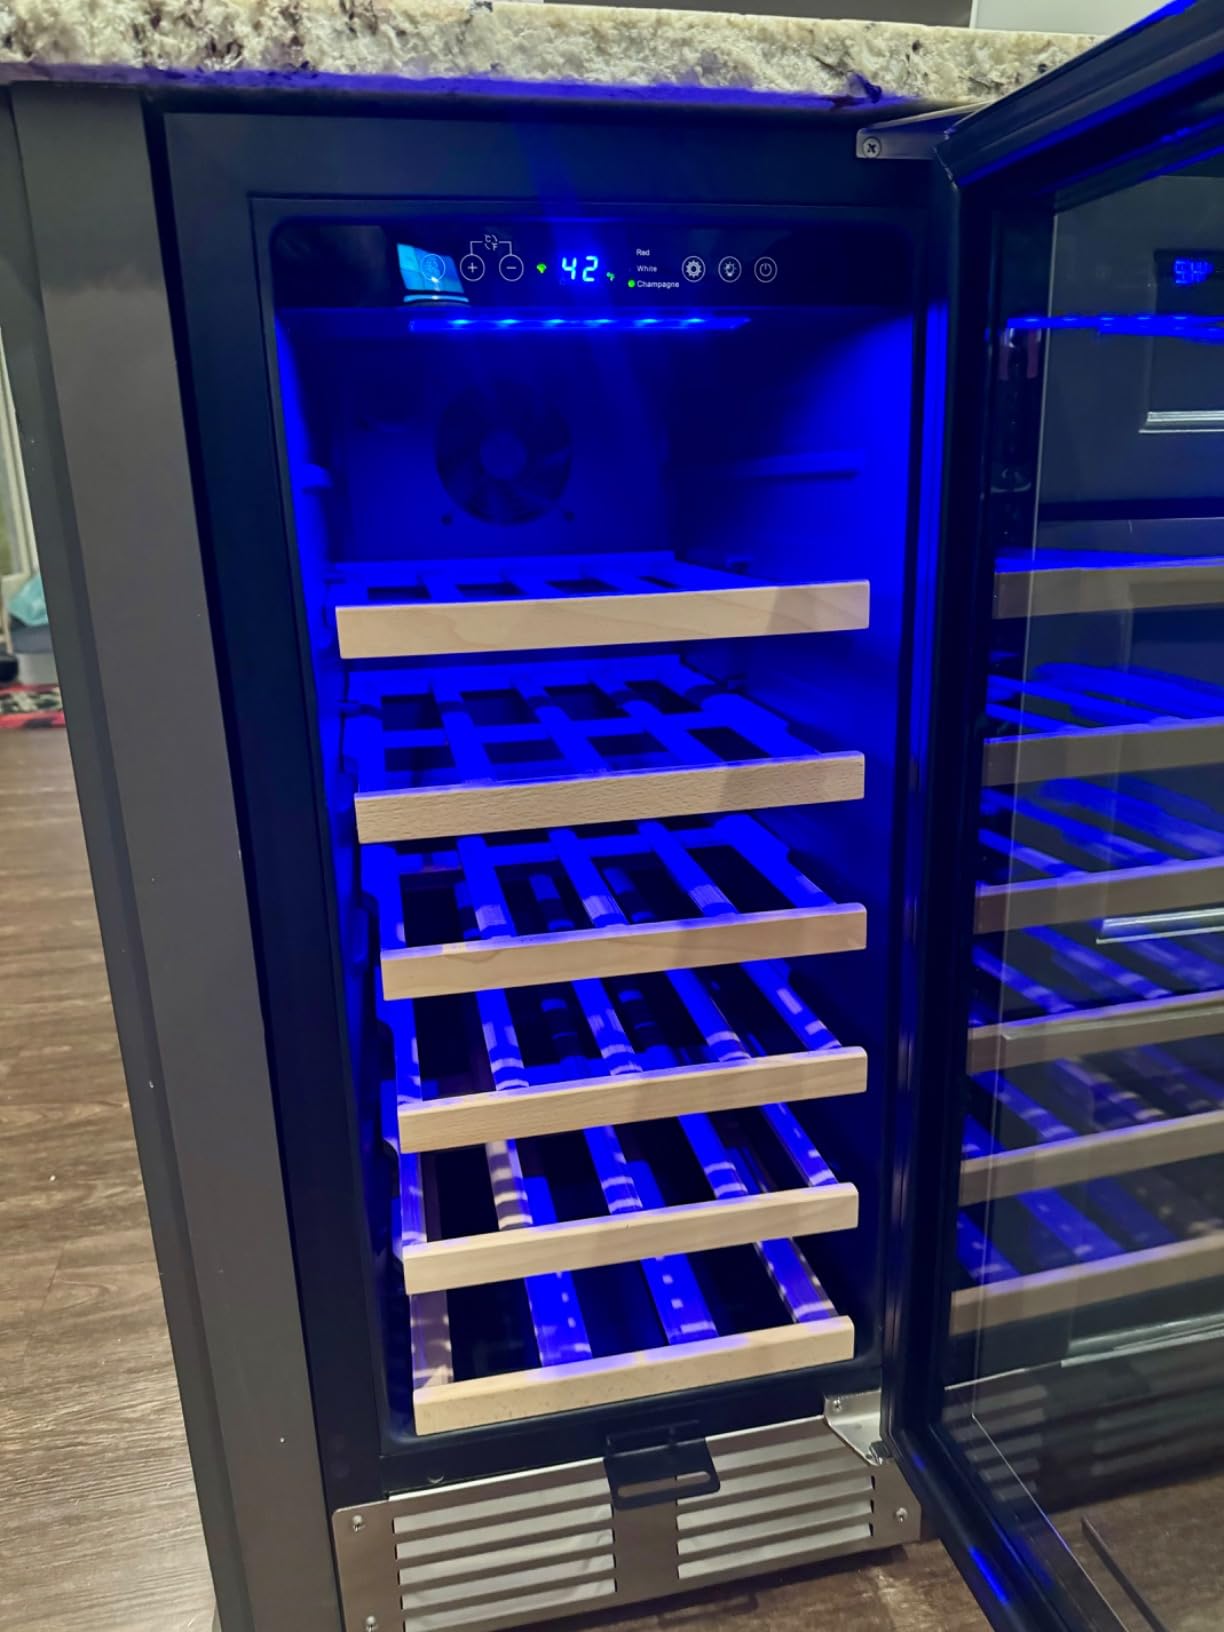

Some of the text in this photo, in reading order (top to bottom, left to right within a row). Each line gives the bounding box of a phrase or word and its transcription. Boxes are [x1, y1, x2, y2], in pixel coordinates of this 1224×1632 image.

[636, 248, 650, 257] Red
[561, 255, 599, 282] 42
[636, 265, 658, 273] White
[636, 280, 680, 289] Champagne
